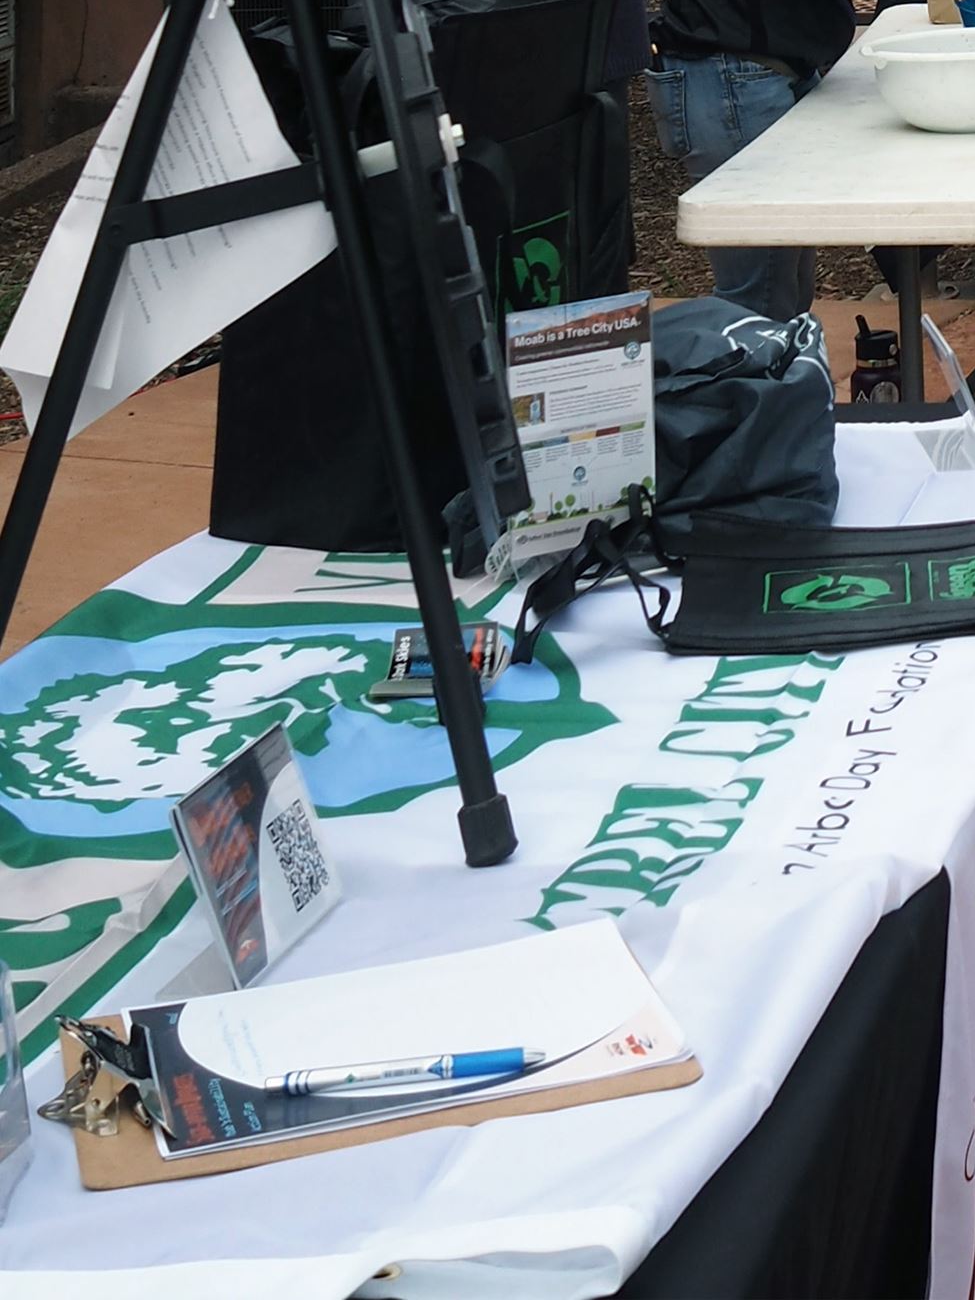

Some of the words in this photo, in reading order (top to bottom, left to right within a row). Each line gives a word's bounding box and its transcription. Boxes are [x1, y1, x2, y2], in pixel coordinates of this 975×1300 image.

[514, 333, 546, 348] Moab
[546, 331, 557, 343] is
[557, 331, 565, 341] a
[566, 327, 591, 340] Tree
[591, 321, 614, 335] City
[395, 636, 411, 662] Skies
[820, 748, 898, 791] Day
